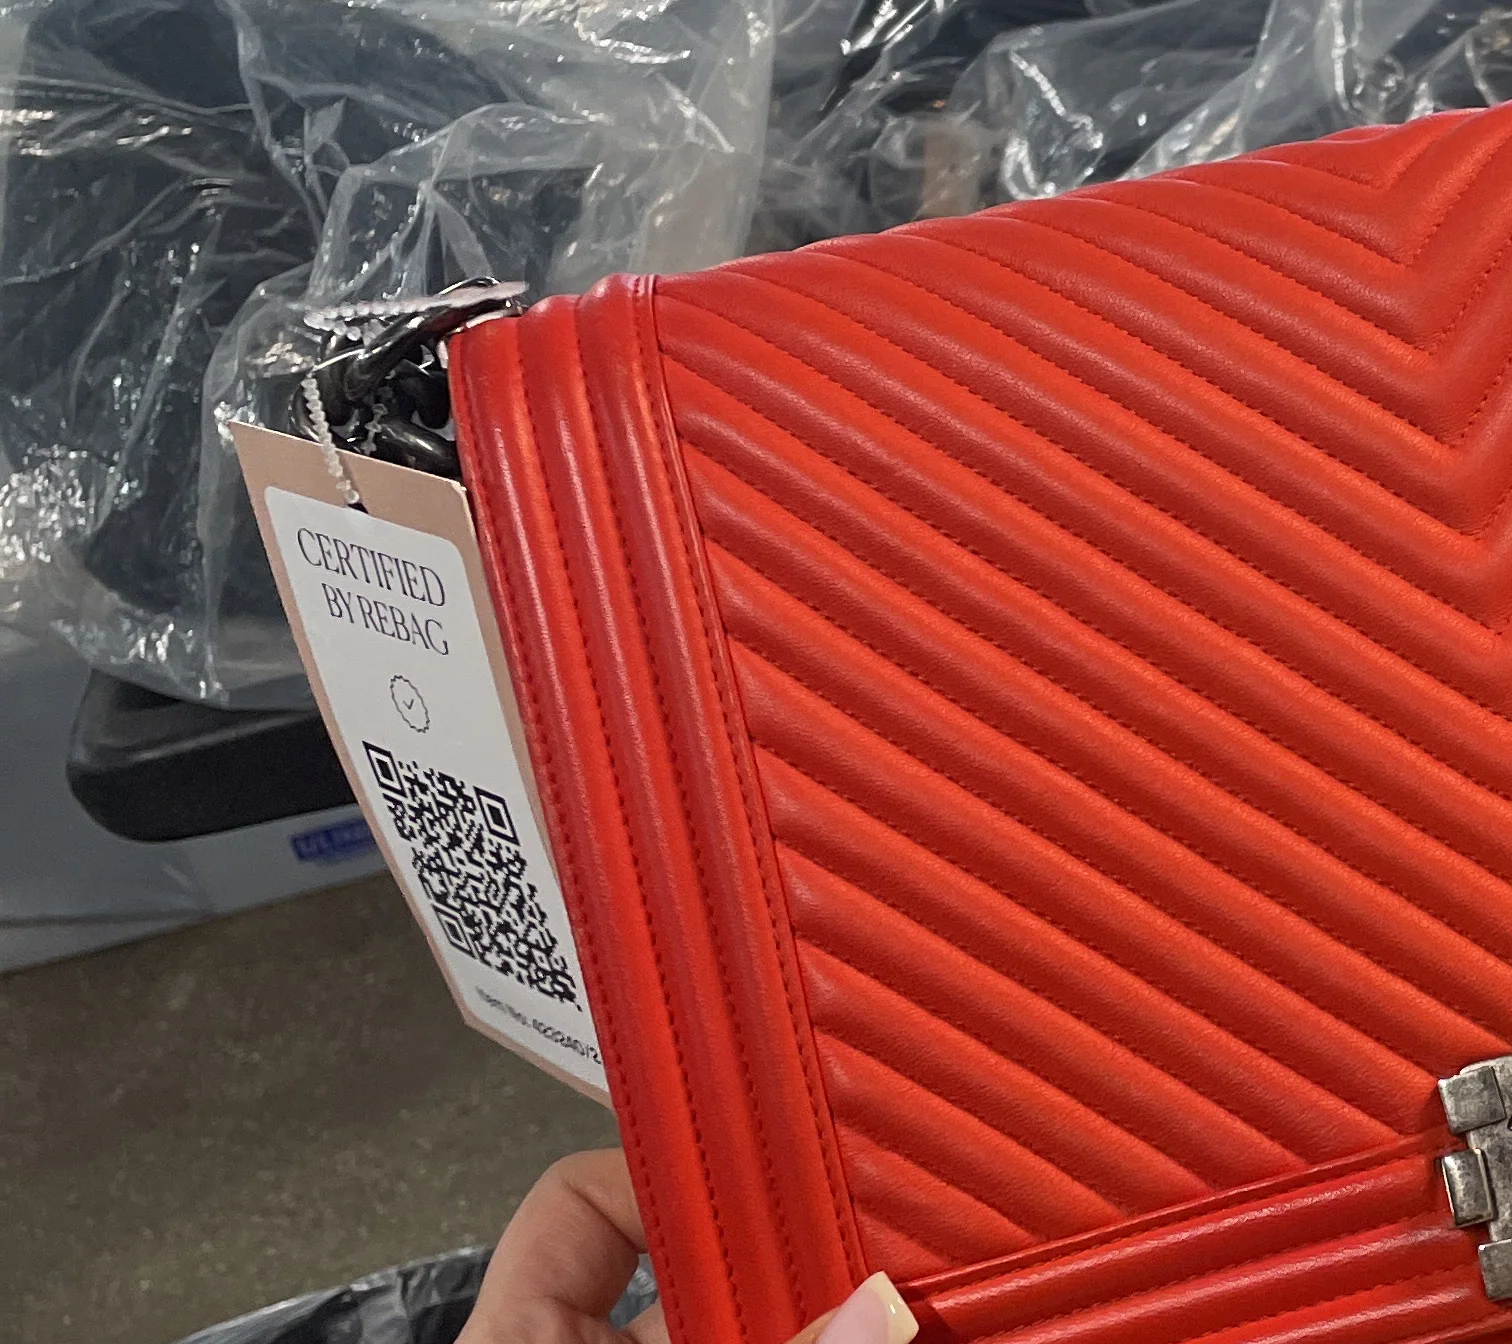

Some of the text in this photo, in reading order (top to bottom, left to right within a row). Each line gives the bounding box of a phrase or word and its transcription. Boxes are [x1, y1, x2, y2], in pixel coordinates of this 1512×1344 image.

[297, 527, 446, 607] CERTIFIED
[321, 582, 449, 656] BY REBAG
